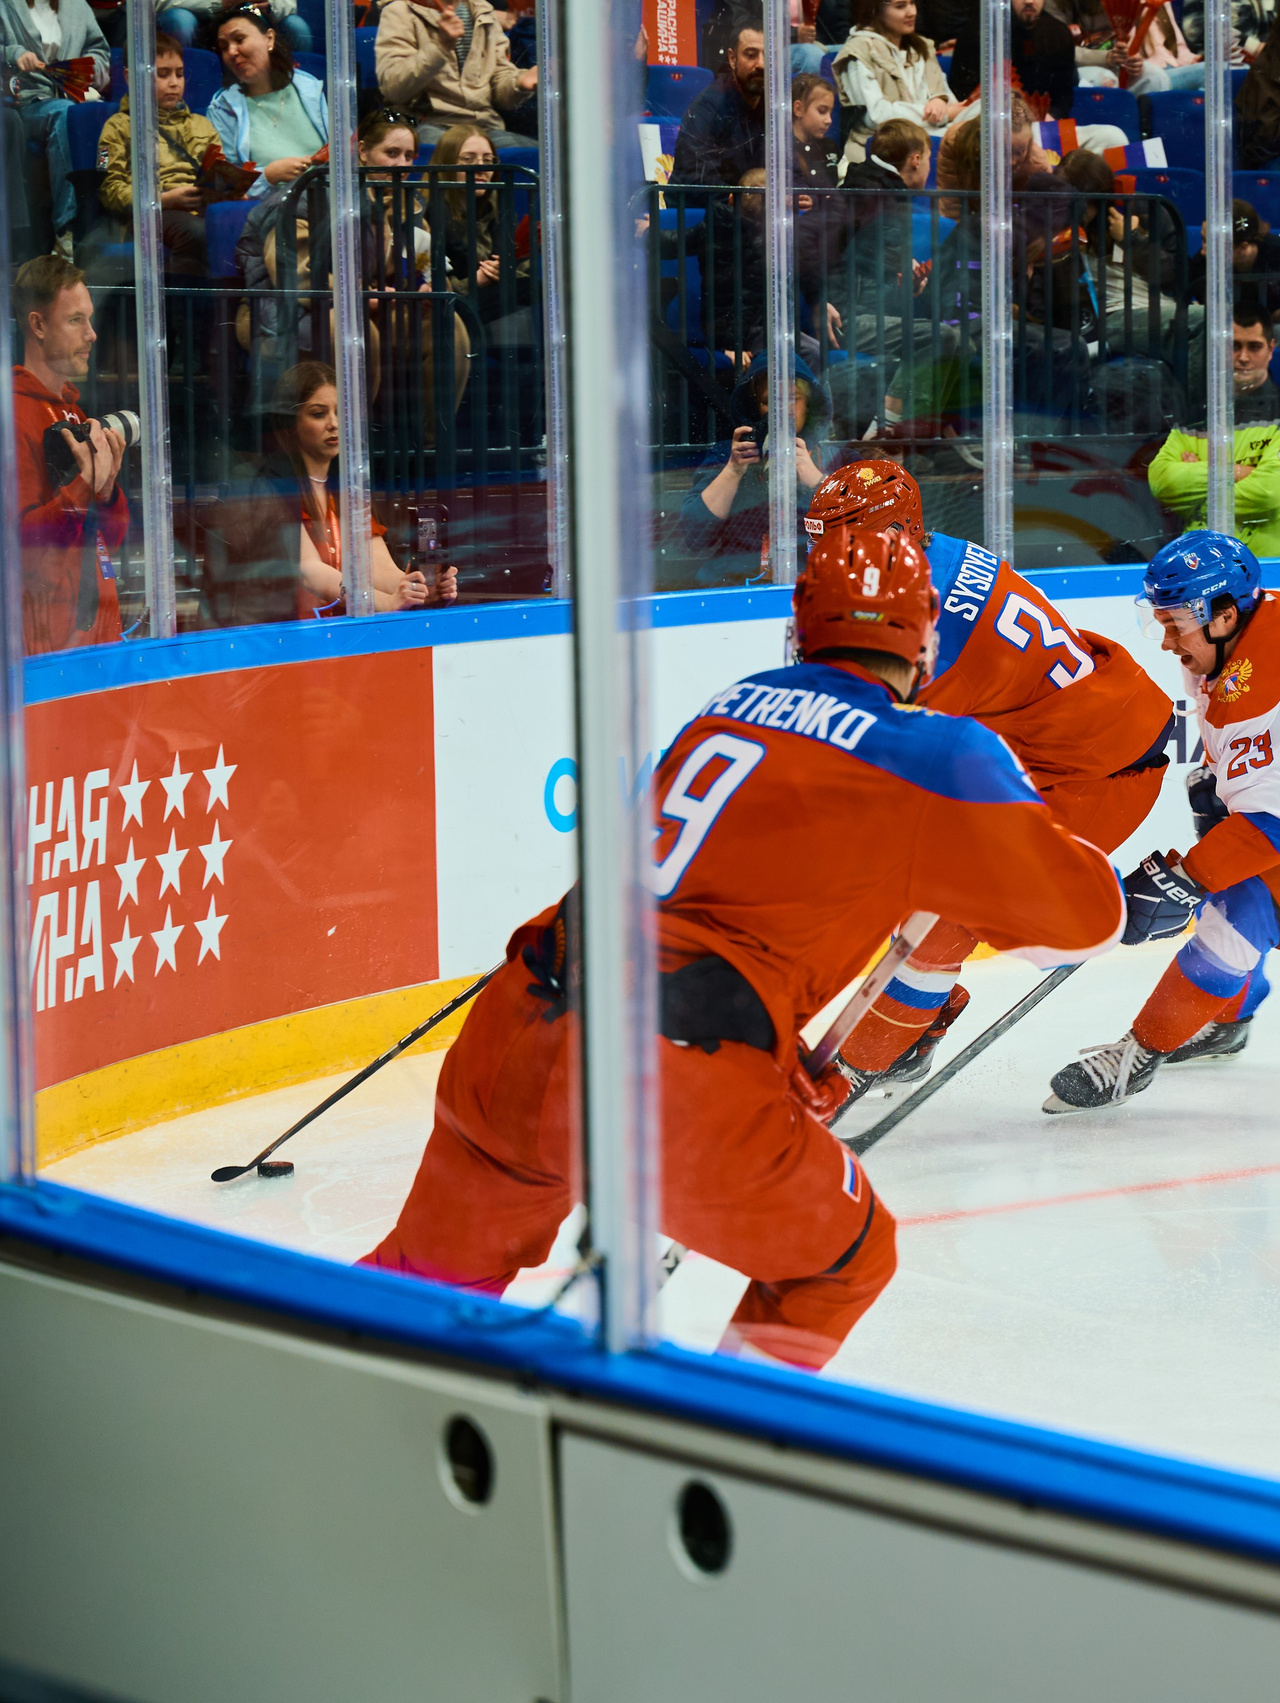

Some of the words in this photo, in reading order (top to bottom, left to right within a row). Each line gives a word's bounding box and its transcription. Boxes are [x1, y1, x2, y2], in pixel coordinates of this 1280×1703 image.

[862, 567, 880, 597] 9
[1202, 580, 1227, 596] CCM
[1227, 730, 1274, 780] 23
[27, 768, 110, 886] НАЯ
[641, 732, 766, 899] 9
